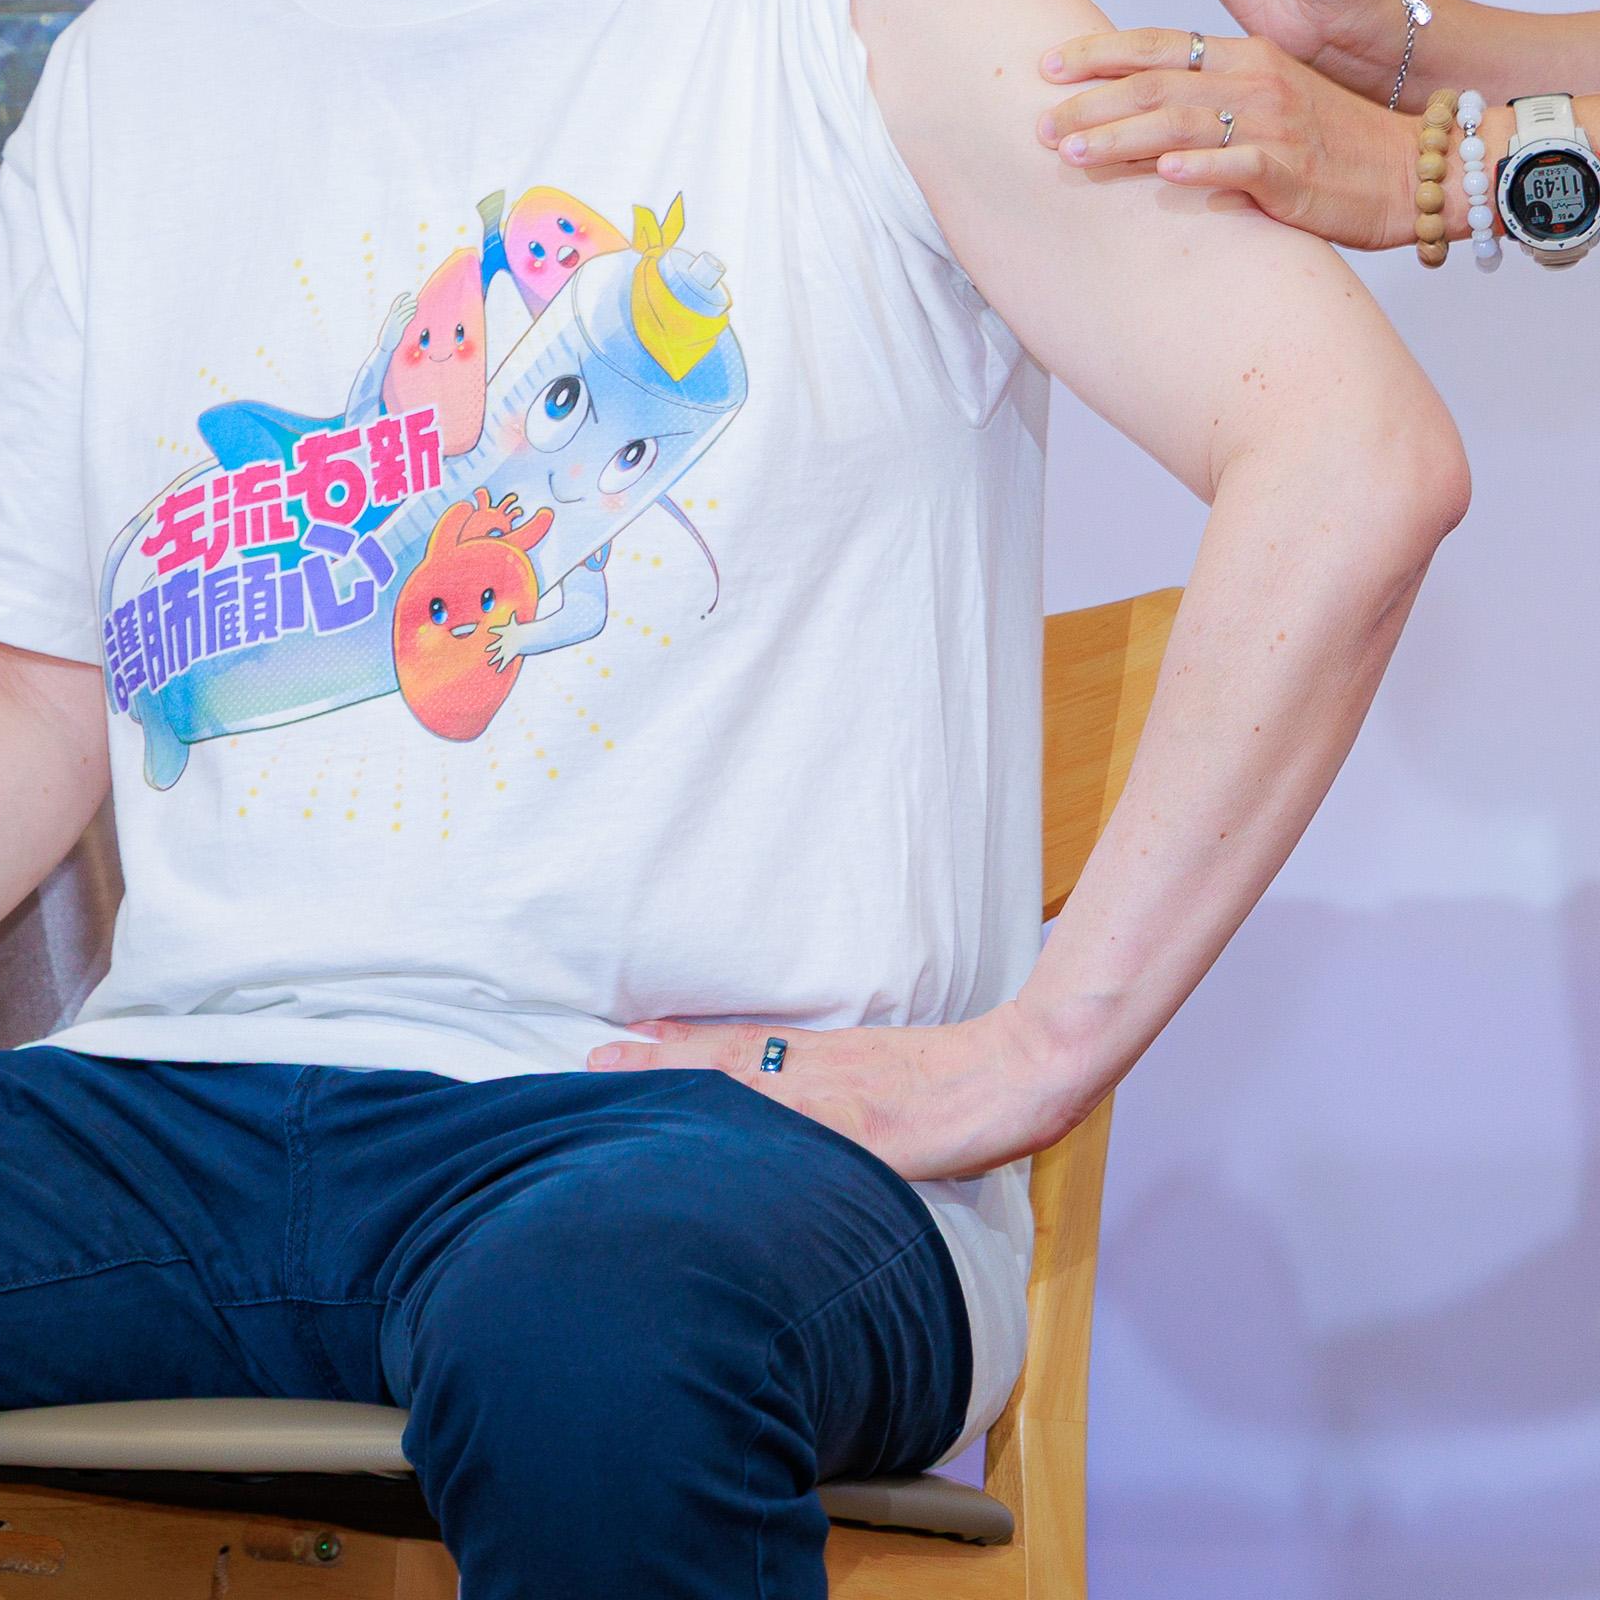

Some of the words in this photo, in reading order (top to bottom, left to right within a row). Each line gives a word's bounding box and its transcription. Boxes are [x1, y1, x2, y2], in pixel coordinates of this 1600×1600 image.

[1533, 174, 1581, 199] 11:49
[140, 407, 441, 576] 左流右新
